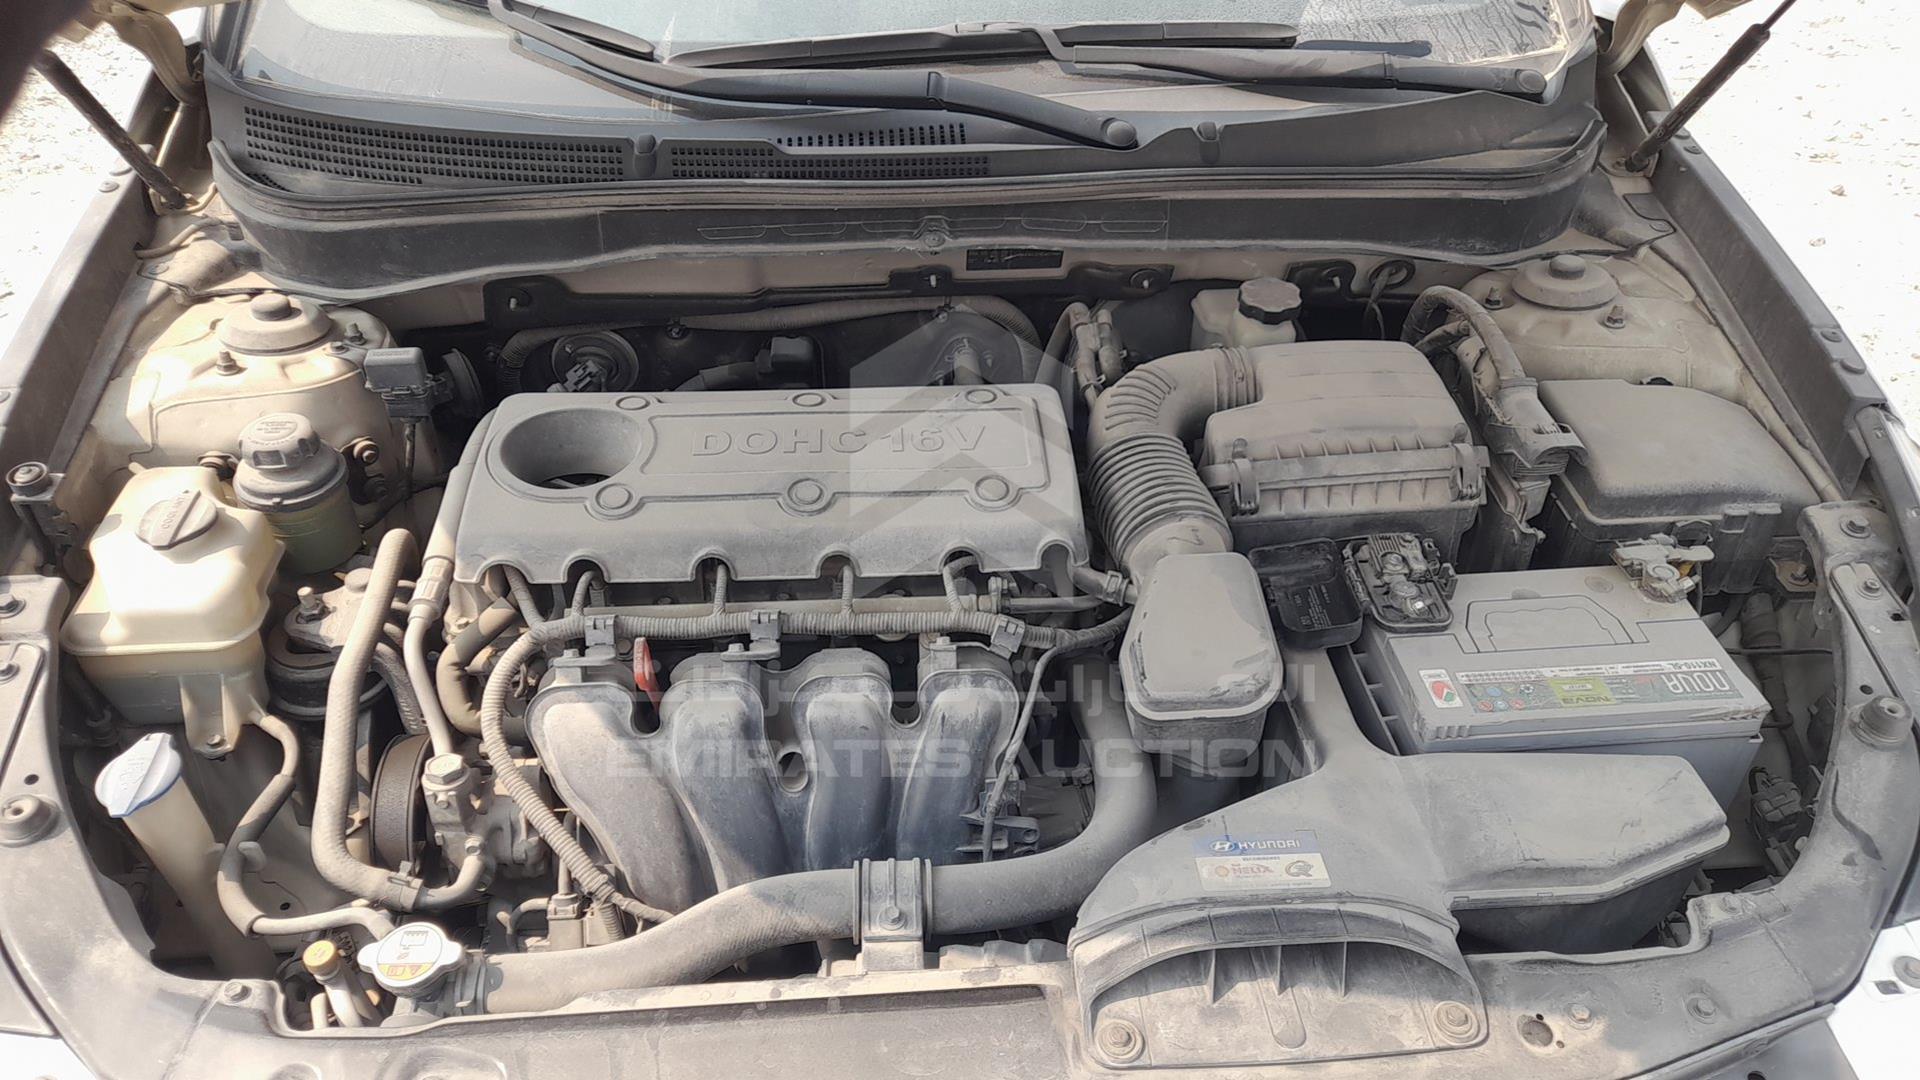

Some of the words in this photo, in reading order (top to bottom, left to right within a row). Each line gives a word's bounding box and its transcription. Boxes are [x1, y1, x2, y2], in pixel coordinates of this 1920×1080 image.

[692, 428, 868, 456] DOHC
[878, 425, 986, 452] 16V
[1660, 671, 1730, 693] NOVA
[1239, 840, 1300, 849] HYUNDAI
